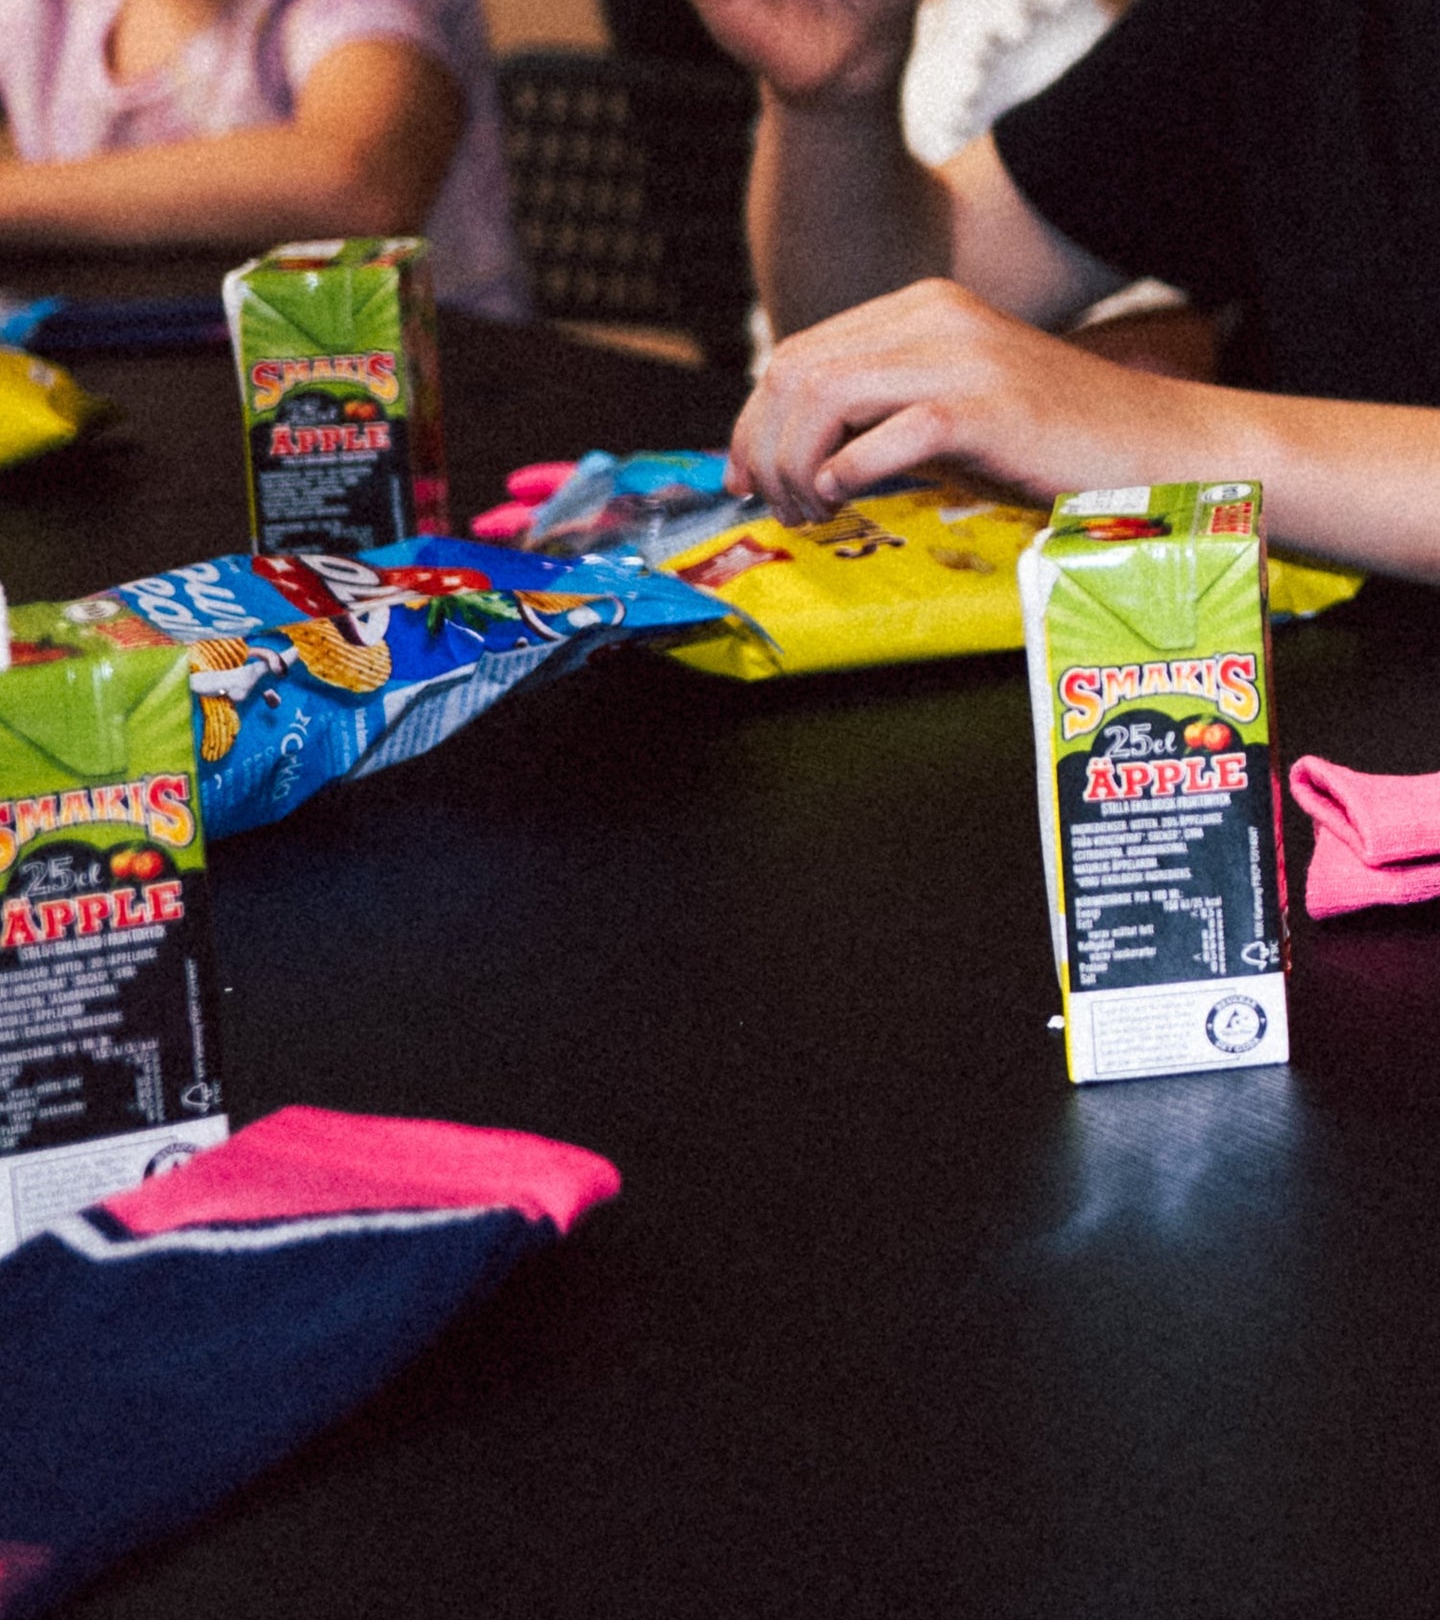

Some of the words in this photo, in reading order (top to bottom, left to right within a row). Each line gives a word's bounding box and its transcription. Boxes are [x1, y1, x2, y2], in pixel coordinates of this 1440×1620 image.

[252, 351, 399, 412] SMAKIS
[1059, 652, 1260, 740] SMAKIS
[1104, 723, 1177, 759] 25cl
[1083, 752, 1248, 803] ÄPPLE
[22, 856, 103, 900] 25cl
[1, 880, 185, 948] ÄPPLE
[1269, 940, 1280, 963] FSC
